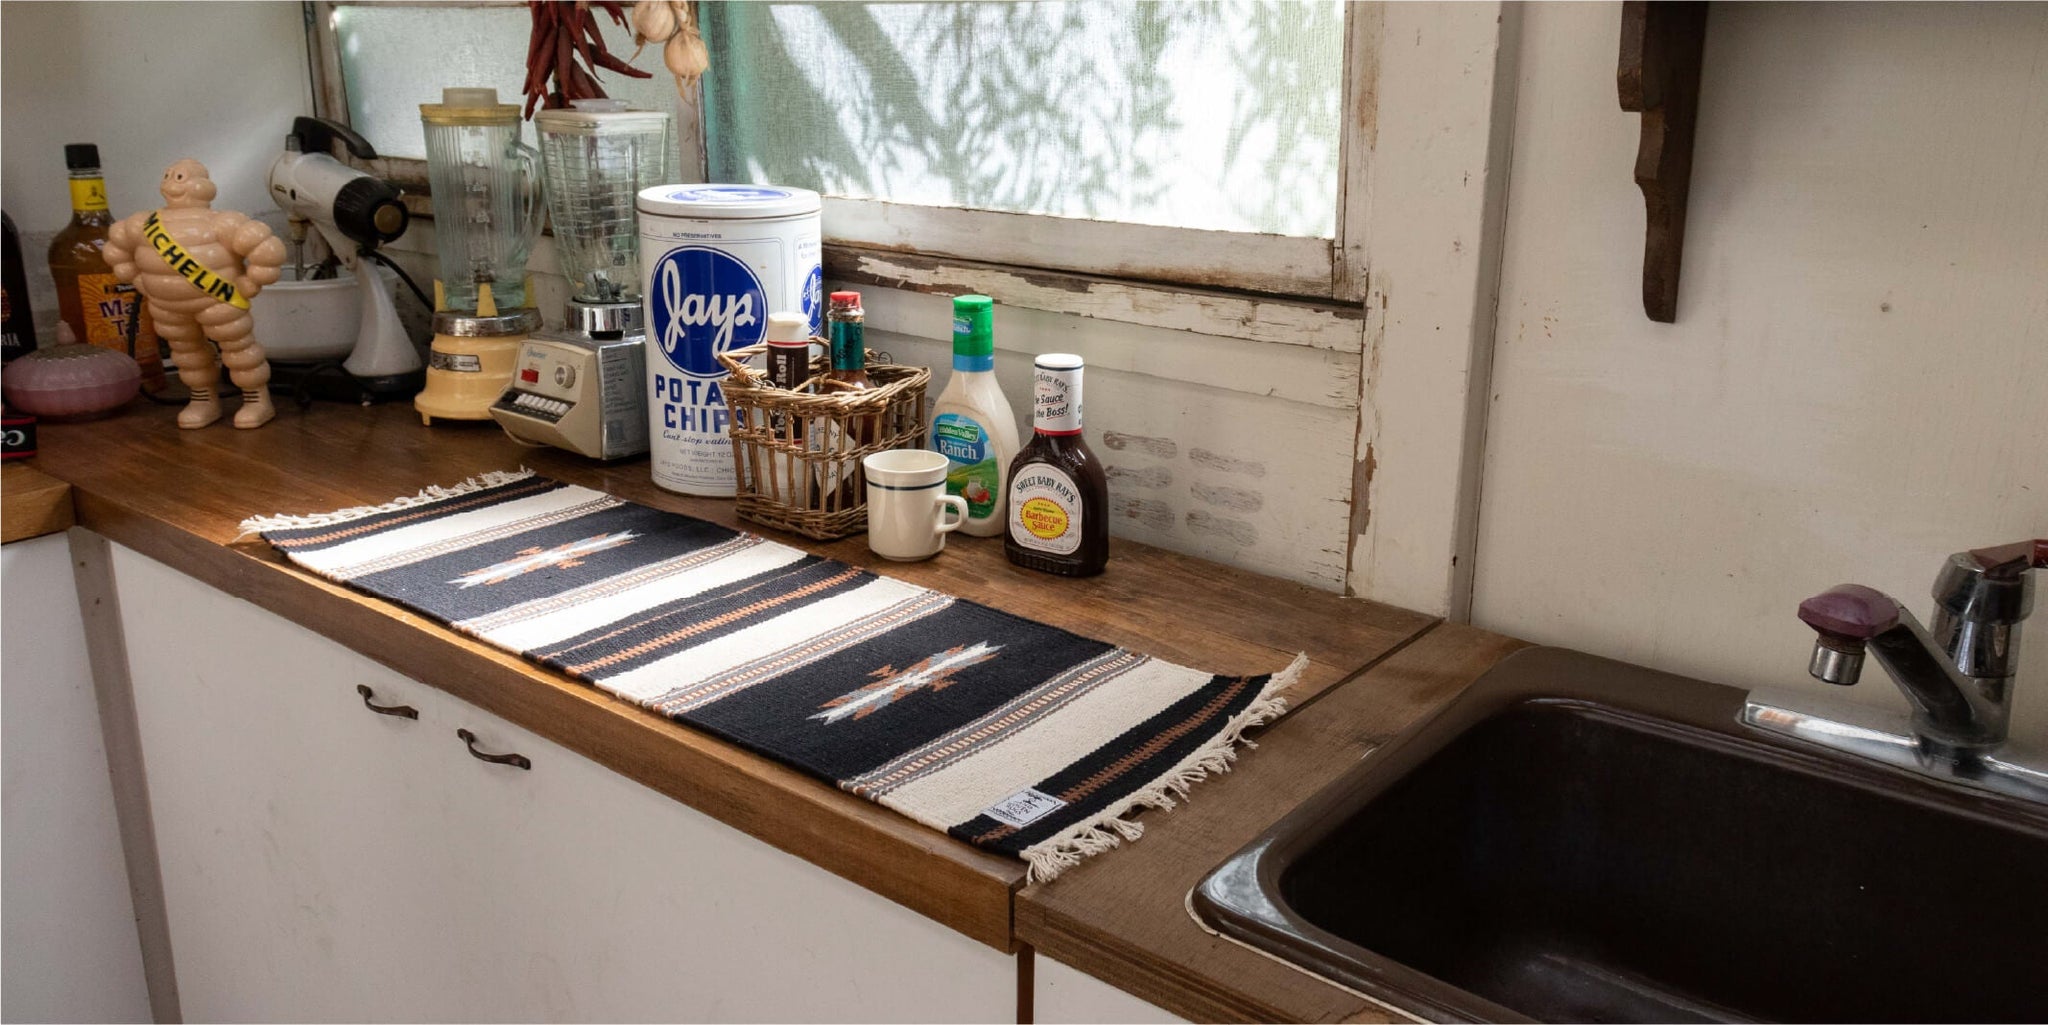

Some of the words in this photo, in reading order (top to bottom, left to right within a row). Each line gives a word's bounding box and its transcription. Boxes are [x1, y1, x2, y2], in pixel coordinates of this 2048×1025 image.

[143, 211, 235, 303] MICHELIN
[99, 298, 136, 318] Ma
[776, 354, 787, 384] Roll
[655, 374, 726, 407] POTA
[1040, 394, 1065, 404] Sauce
[1046, 402, 1069, 418] Boss!
[940, 439, 978, 460] Ranch
[1016, 477, 1036, 493] SWEET
[1037, 476, 1056, 488] BABY
[1055, 482, 1076, 503] RAY'S
[1025, 510, 1063, 526] Barbecue
[1032, 520, 1056, 532] Sauce
